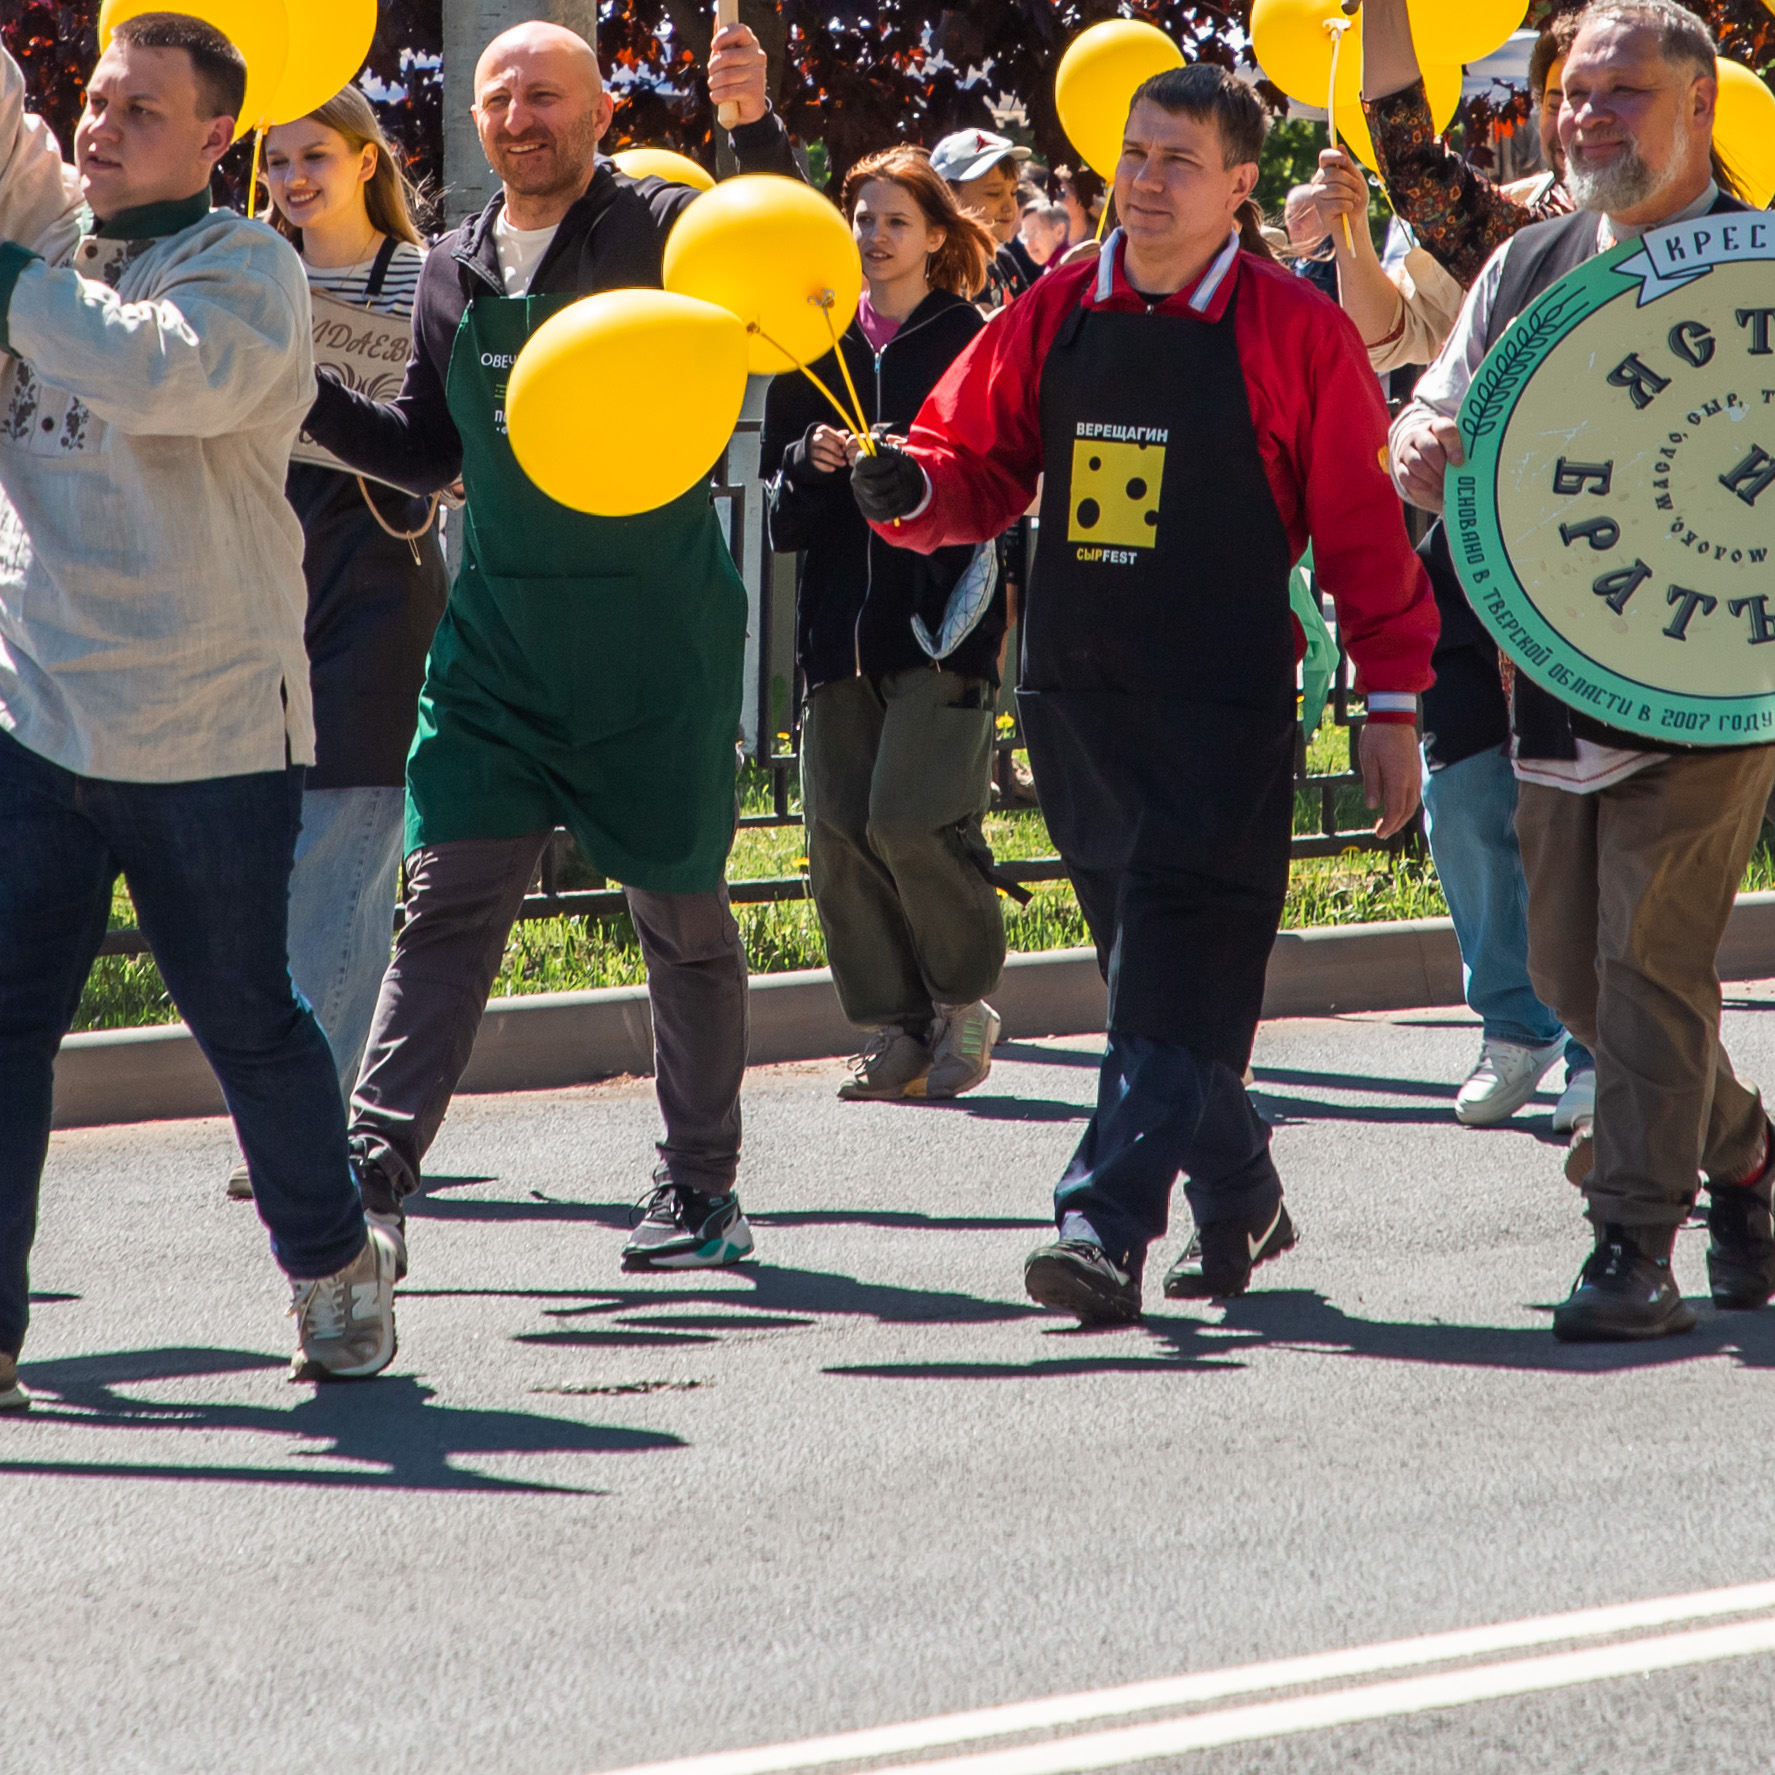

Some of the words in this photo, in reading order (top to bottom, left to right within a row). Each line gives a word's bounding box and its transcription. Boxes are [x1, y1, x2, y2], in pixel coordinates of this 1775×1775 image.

[1687, 393, 1743, 425] СЫР,
[1076, 422, 1168, 443] ВЕРЕЩАГИН
[1653, 432, 1688, 511] МАСЛО,
[1077, 548, 1138, 565] СЫРFEST
[1670, 516, 1768, 563] МОЛОКО,
[1457, 476, 1485, 564] ОСНОВАНО
[1472, 569, 1491, 584] В
[1482, 587, 1554, 667] ТВЕРСКОЙ
[1548, 662, 1634, 716] ОБЛАСТИ
[1637, 703, 1652, 723] В
[1661, 708, 1711, 732] 2007
[1718, 710, 1773, 734] ГОДУ
